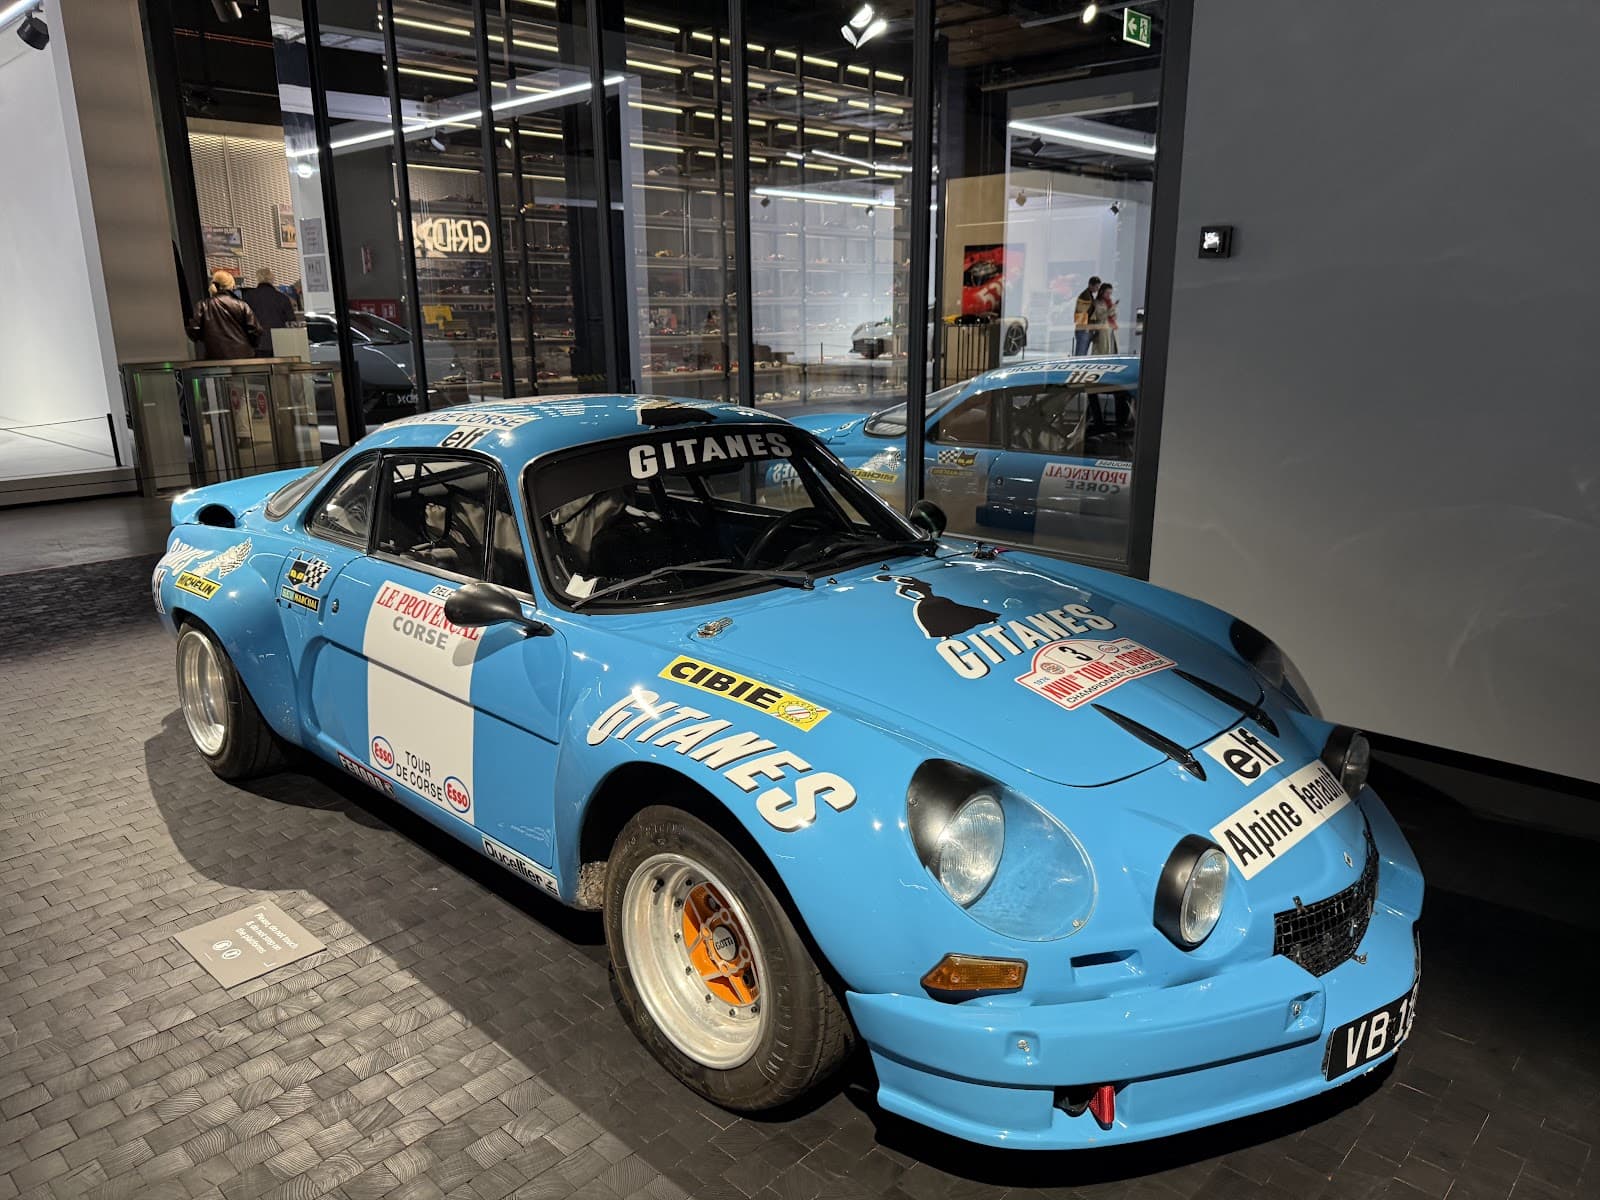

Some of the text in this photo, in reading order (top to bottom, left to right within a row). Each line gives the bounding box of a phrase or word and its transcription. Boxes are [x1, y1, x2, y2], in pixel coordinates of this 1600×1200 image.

[441, 427, 489, 448] elf
[628, 432, 793, 480] GITANES
[178, 574, 216, 596] MICHELIN
[376, 586, 398, 609] LE
[392, 616, 449, 650] CORSE
[936, 603, 1117, 680] GITANES
[1058, 646, 1094, 661] 3
[1074, 660, 1120, 683] TOUR
[1115, 648, 1161, 667] CORSE
[1066, 671, 1128, 704] CHAMPIONNAT
[1137, 659, 1168, 673] MONDE
[374, 743, 392, 765] Esso
[405, 750, 432, 778] TOUR
[586, 689, 858, 832] GITANES
[1223, 728, 1280, 779] elf
[395, 763, 443, 802] DE CORSE
[446, 782, 468, 808] Esso
[1223, 801, 1303, 867] Alpine
[484, 840, 543, 886] Ducellier
[1346, 1011, 1390, 1069] VB
